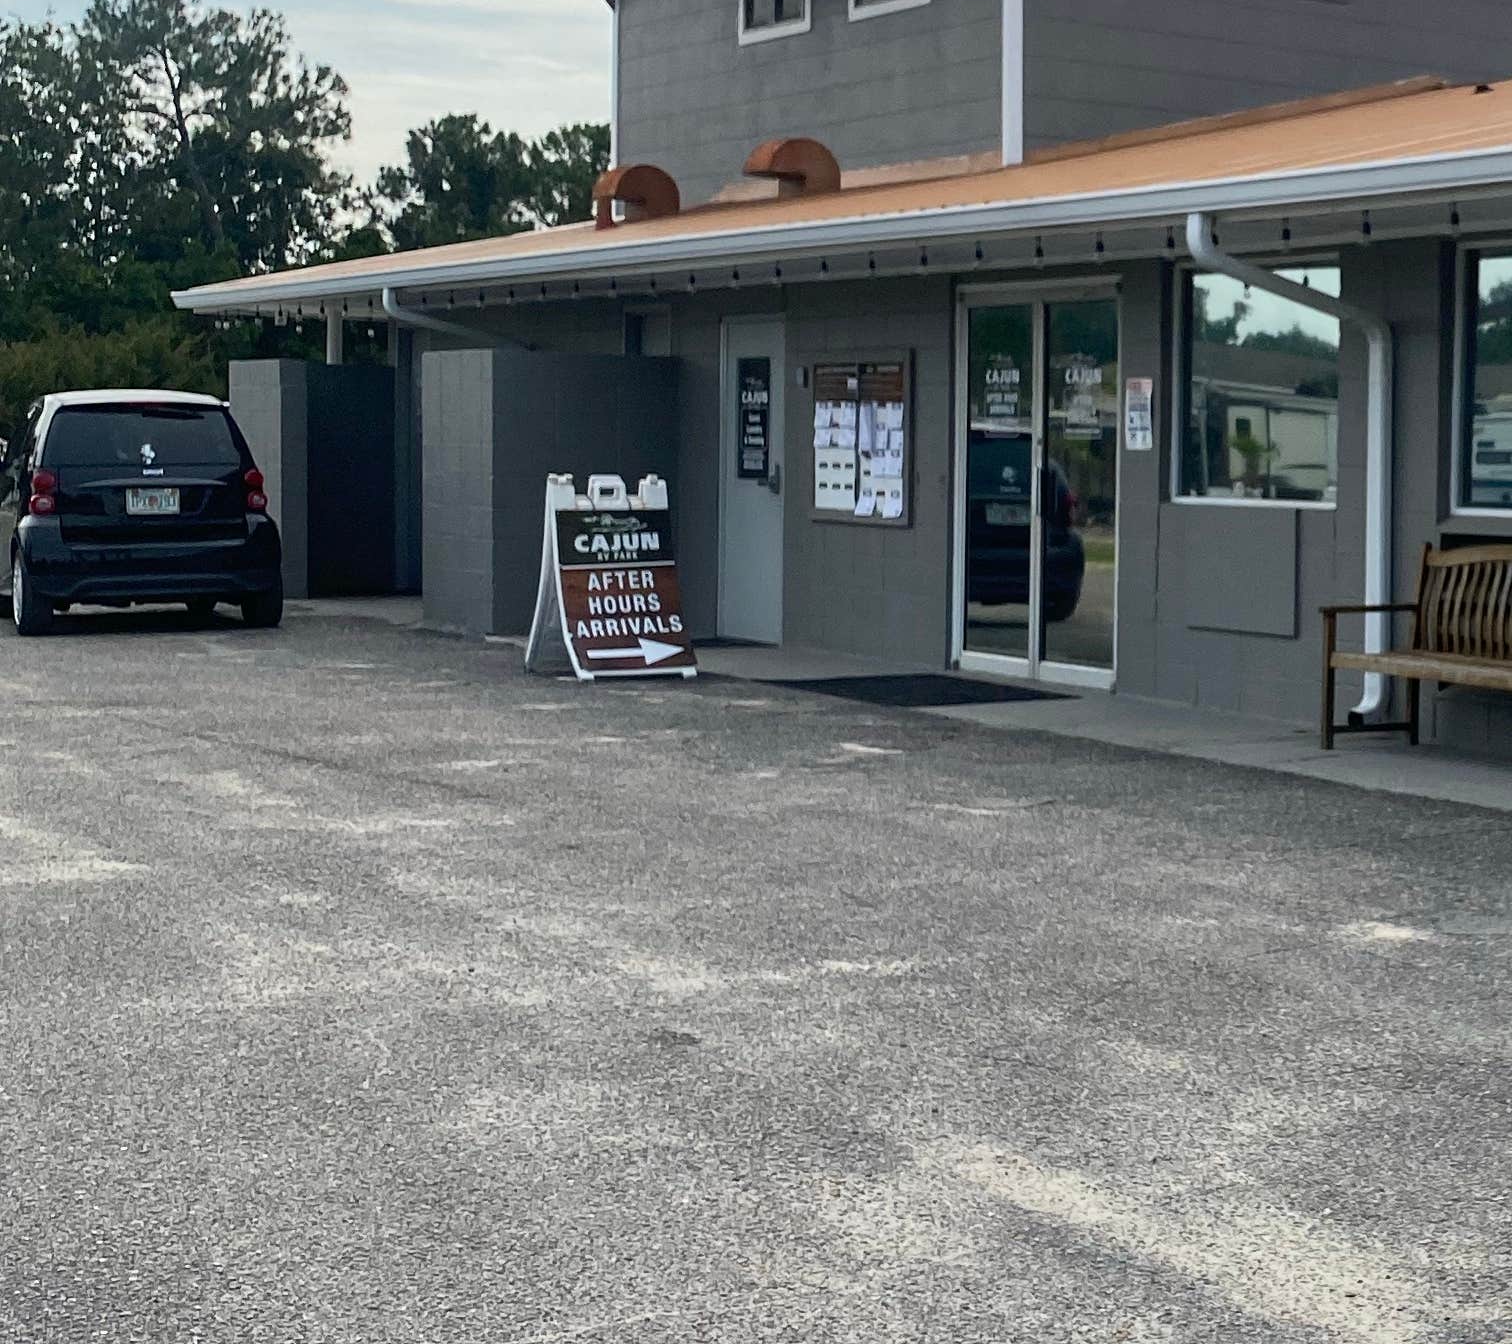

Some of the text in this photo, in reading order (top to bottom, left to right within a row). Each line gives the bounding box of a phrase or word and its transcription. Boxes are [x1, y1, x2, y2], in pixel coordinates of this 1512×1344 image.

[985, 367, 1020, 384] CAJUN
[1065, 367, 1102, 384] CAJUN
[574, 533, 660, 553] CAJUN
[588, 570, 655, 591] AFTER
[588, 592, 661, 615] HOURS
[577, 614, 684, 639] ARRIVALS
